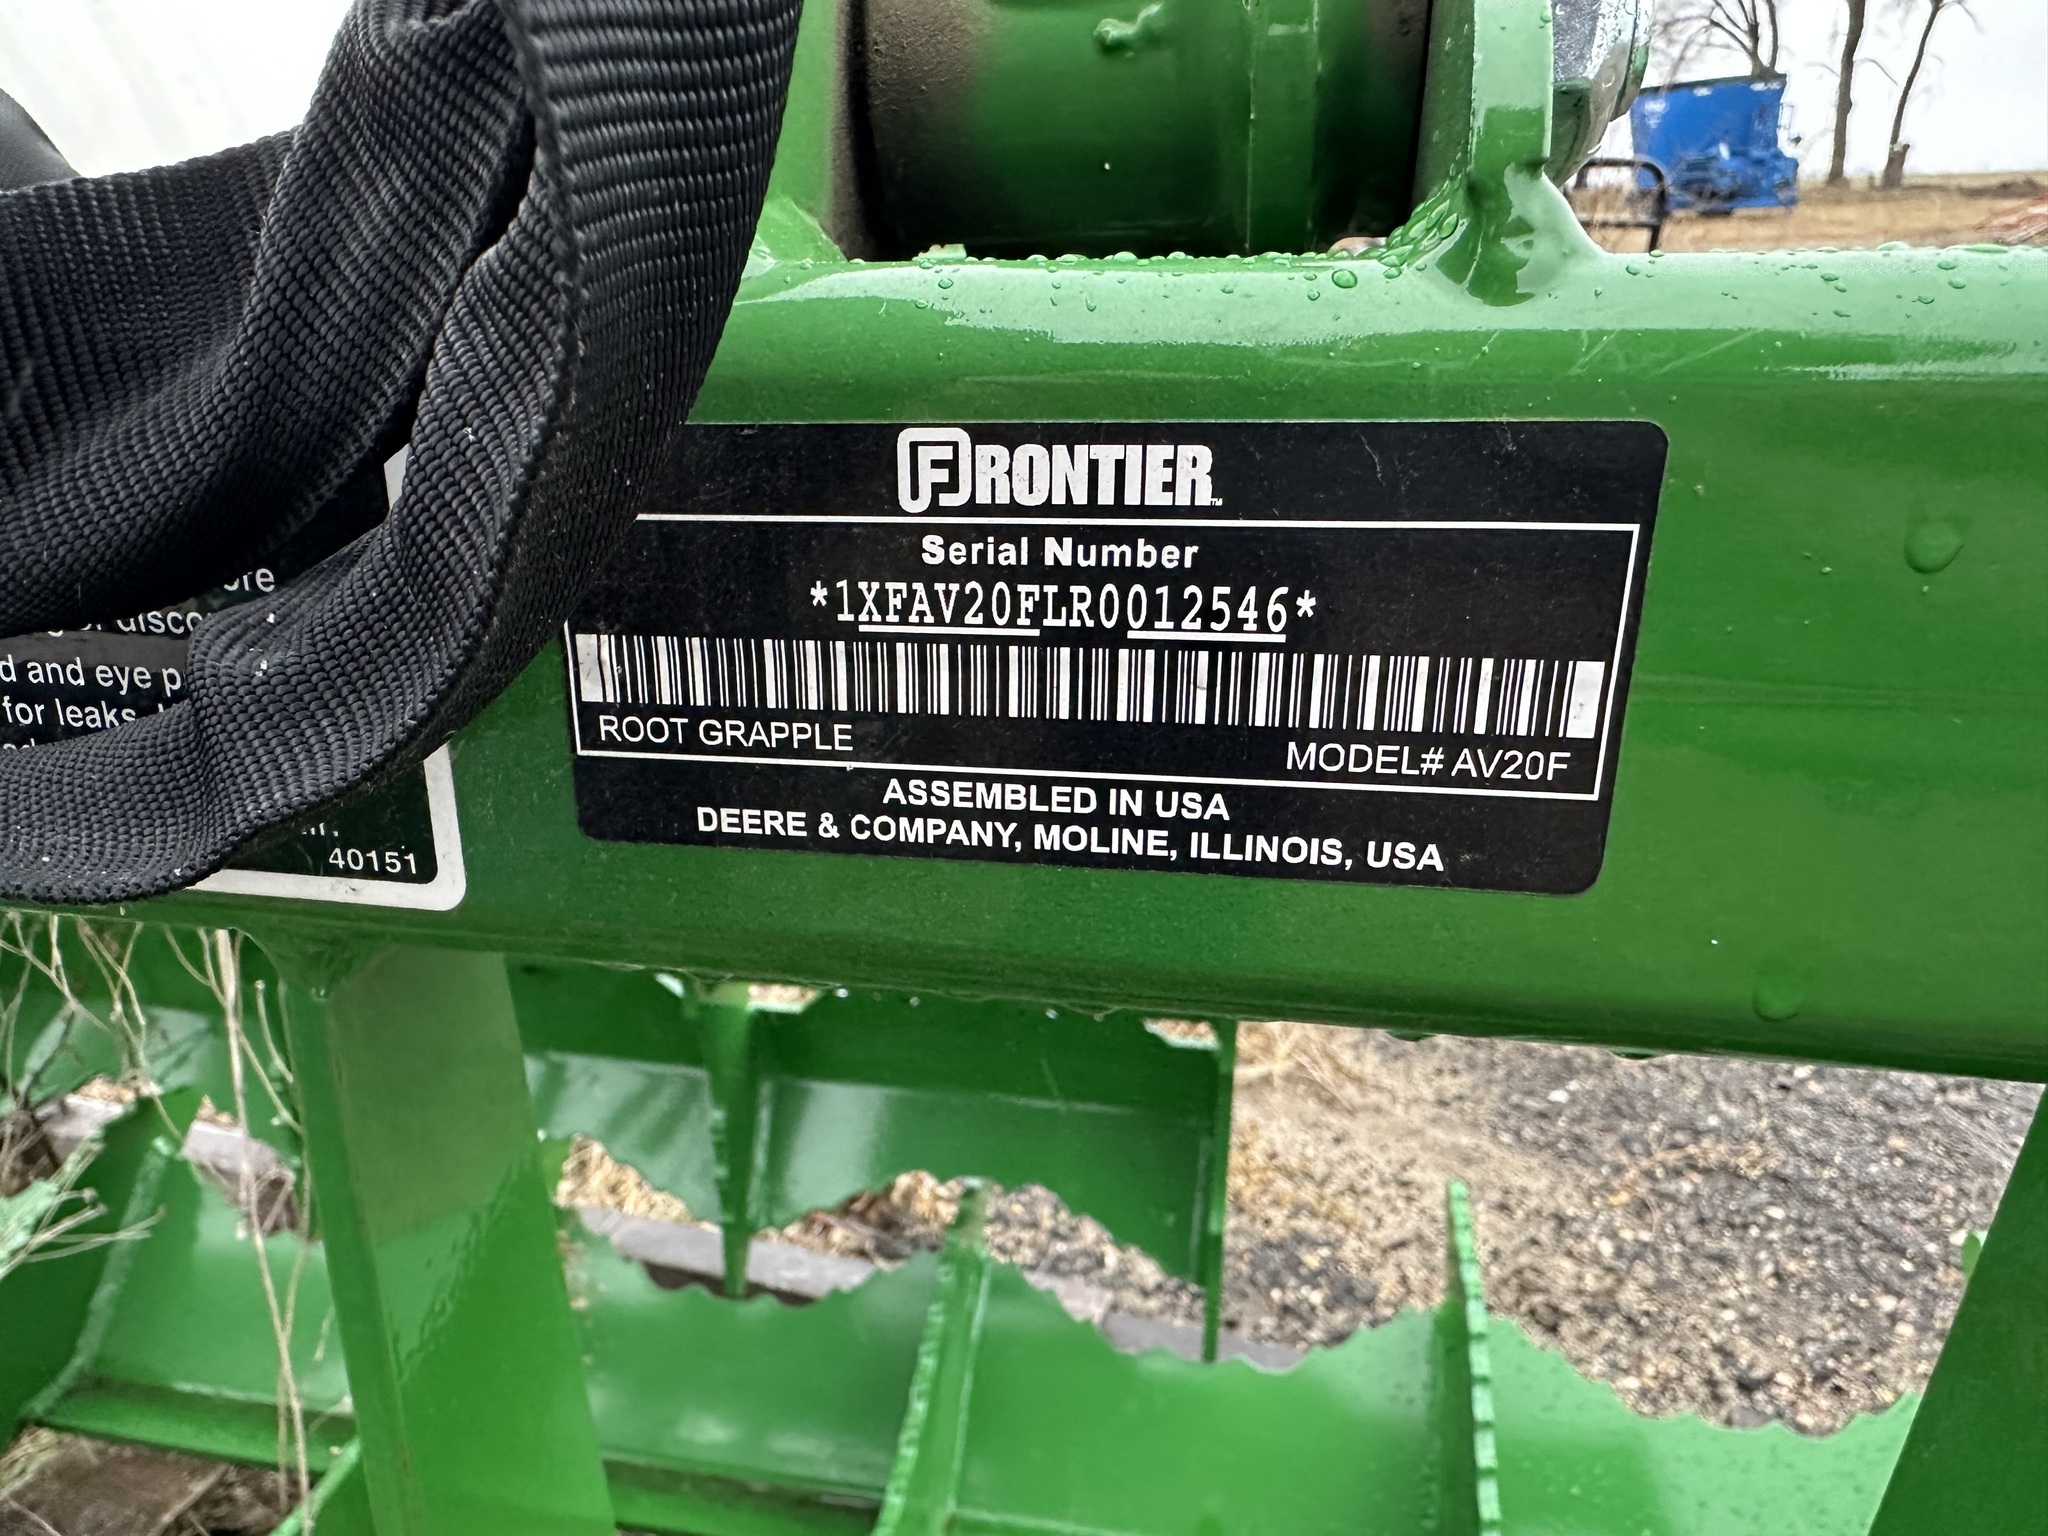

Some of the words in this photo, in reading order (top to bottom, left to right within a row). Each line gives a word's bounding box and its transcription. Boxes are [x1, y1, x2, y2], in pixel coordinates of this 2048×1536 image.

[897, 428, 1212, 513] FRONTIER
[922, 535, 1029, 566] Serial
[1044, 536, 1200, 569] Number
[27, 656, 85, 686] and
[95, 664, 152, 696] eye
[2, 695, 45, 725] for
[599, 714, 689, 745] ROOT
[699, 719, 854, 751] GRAPPLE
[1286, 741, 1445, 776] MODEL#
[1450, 747, 1572, 781] AV20F
[883, 778, 1098, 814] ASSEMBLED
[1109, 788, 1143, 817] IN
[1155, 790, 1230, 821] USA
[696, 806, 808, 837] DEERE
[818, 811, 841, 839] &
[850, 813, 1022, 853] COMPANY,
[1033, 823, 1178, 862] MOLINE,
[1190, 831, 1353, 871] ILLINOIS,
[1366, 840, 1445, 872] USA
[328, 847, 417, 875] 40151
